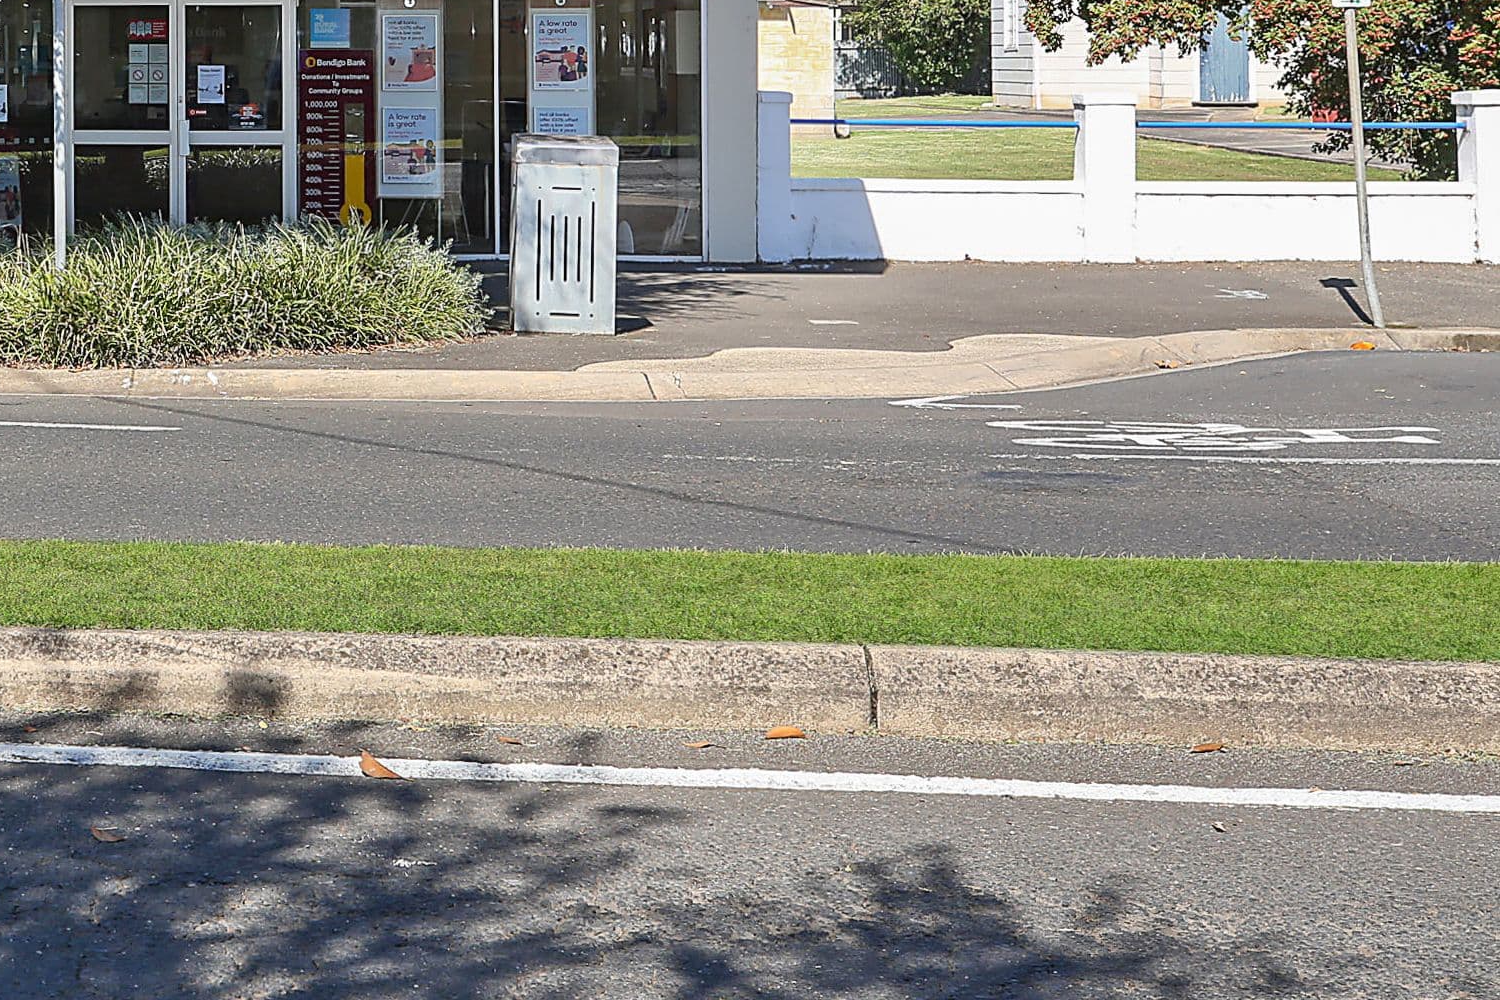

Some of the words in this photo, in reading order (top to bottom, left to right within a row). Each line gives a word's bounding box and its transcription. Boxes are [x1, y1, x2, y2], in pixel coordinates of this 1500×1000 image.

[539, 19, 546, 27] A
[547, 19, 561, 27] low
[546, 28, 567, 36] great
[316, 58, 346, 68] Bendigo
[346, 58, 367, 67] Bank
[308, 87, 341, 95] Community
[341, 87, 363, 95] Groups
[395, 121, 417, 129] great
